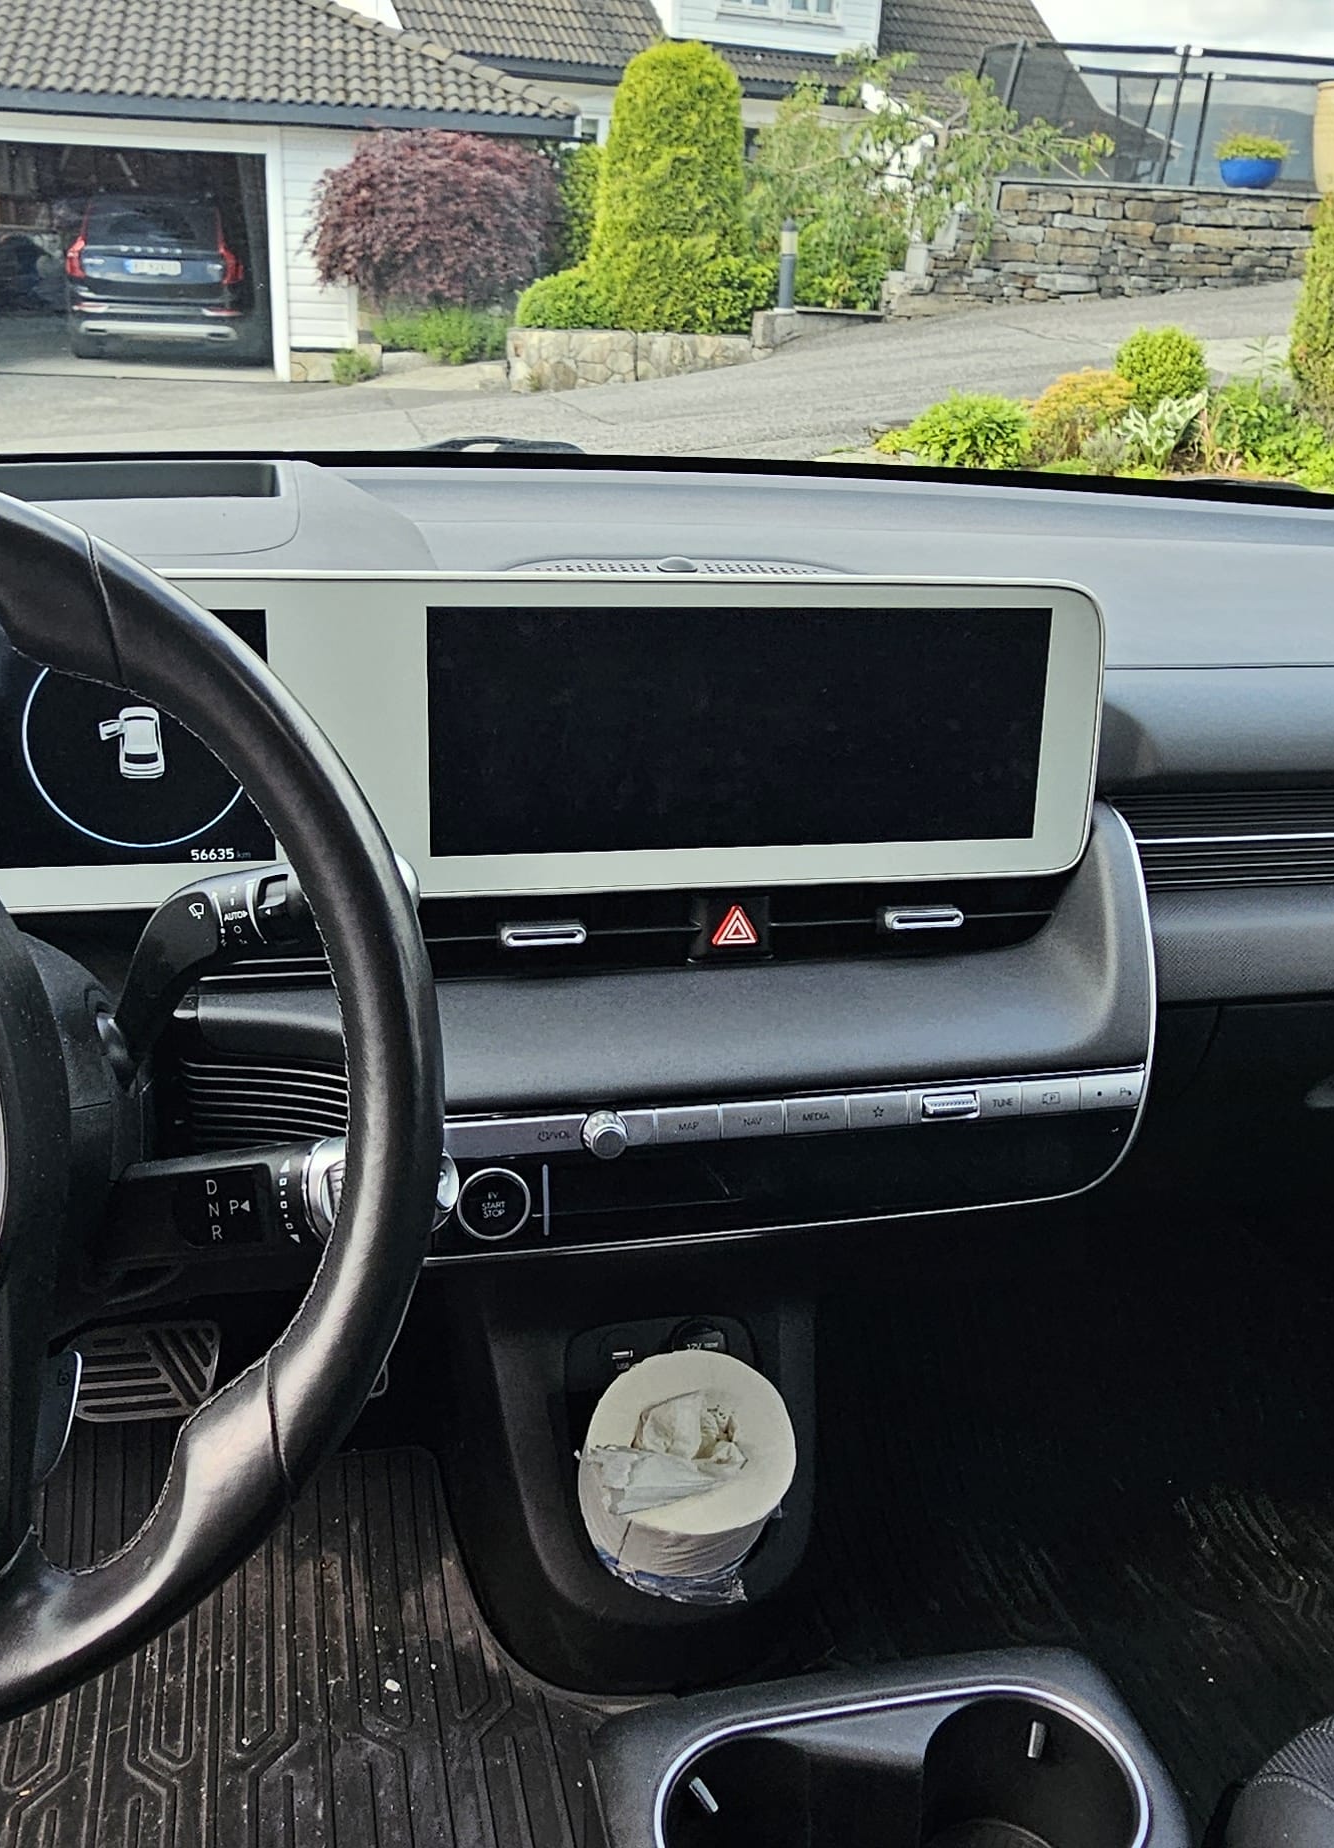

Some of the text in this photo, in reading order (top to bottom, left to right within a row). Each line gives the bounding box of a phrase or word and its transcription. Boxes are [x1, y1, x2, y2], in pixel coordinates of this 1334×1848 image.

[190, 848, 251, 861] 56635 km
[223, 910, 243, 922] AUTO
[992, 1097, 1014, 1108] TUNE
[802, 1111, 830, 1121] MEDIA
[678, 1121, 699, 1131] MAP
[743, 1117, 763, 1127] NAV
[205, 1179, 218, 1195] D
[208, 1199, 239, 1217] N P
[481, 1201, 506, 1211] START
[482, 1209, 506, 1219] STOP
[211, 1224, 223, 1240] R
